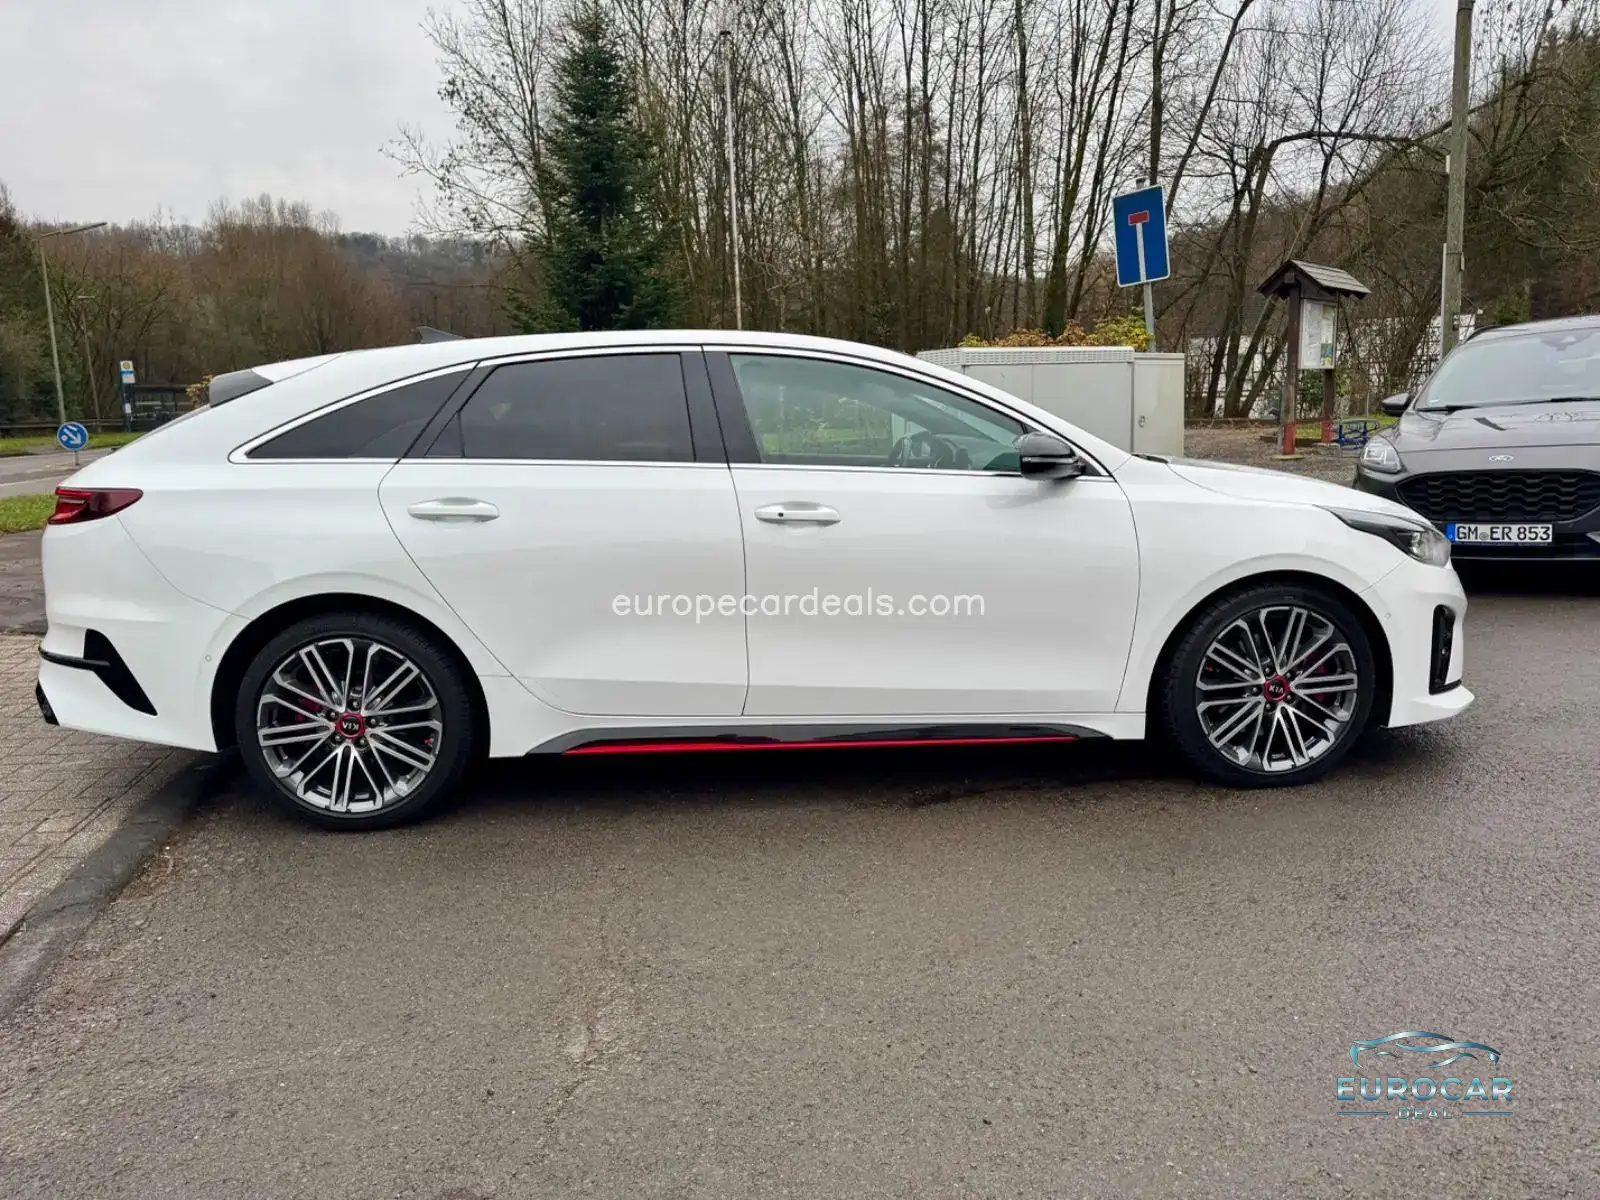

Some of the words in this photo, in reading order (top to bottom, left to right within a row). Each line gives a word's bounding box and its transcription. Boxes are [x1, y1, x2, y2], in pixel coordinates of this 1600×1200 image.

[1456, 525, 1479, 540] GM
[1489, 525, 1512, 541] ER
[1516, 526, 1551, 541] 853
